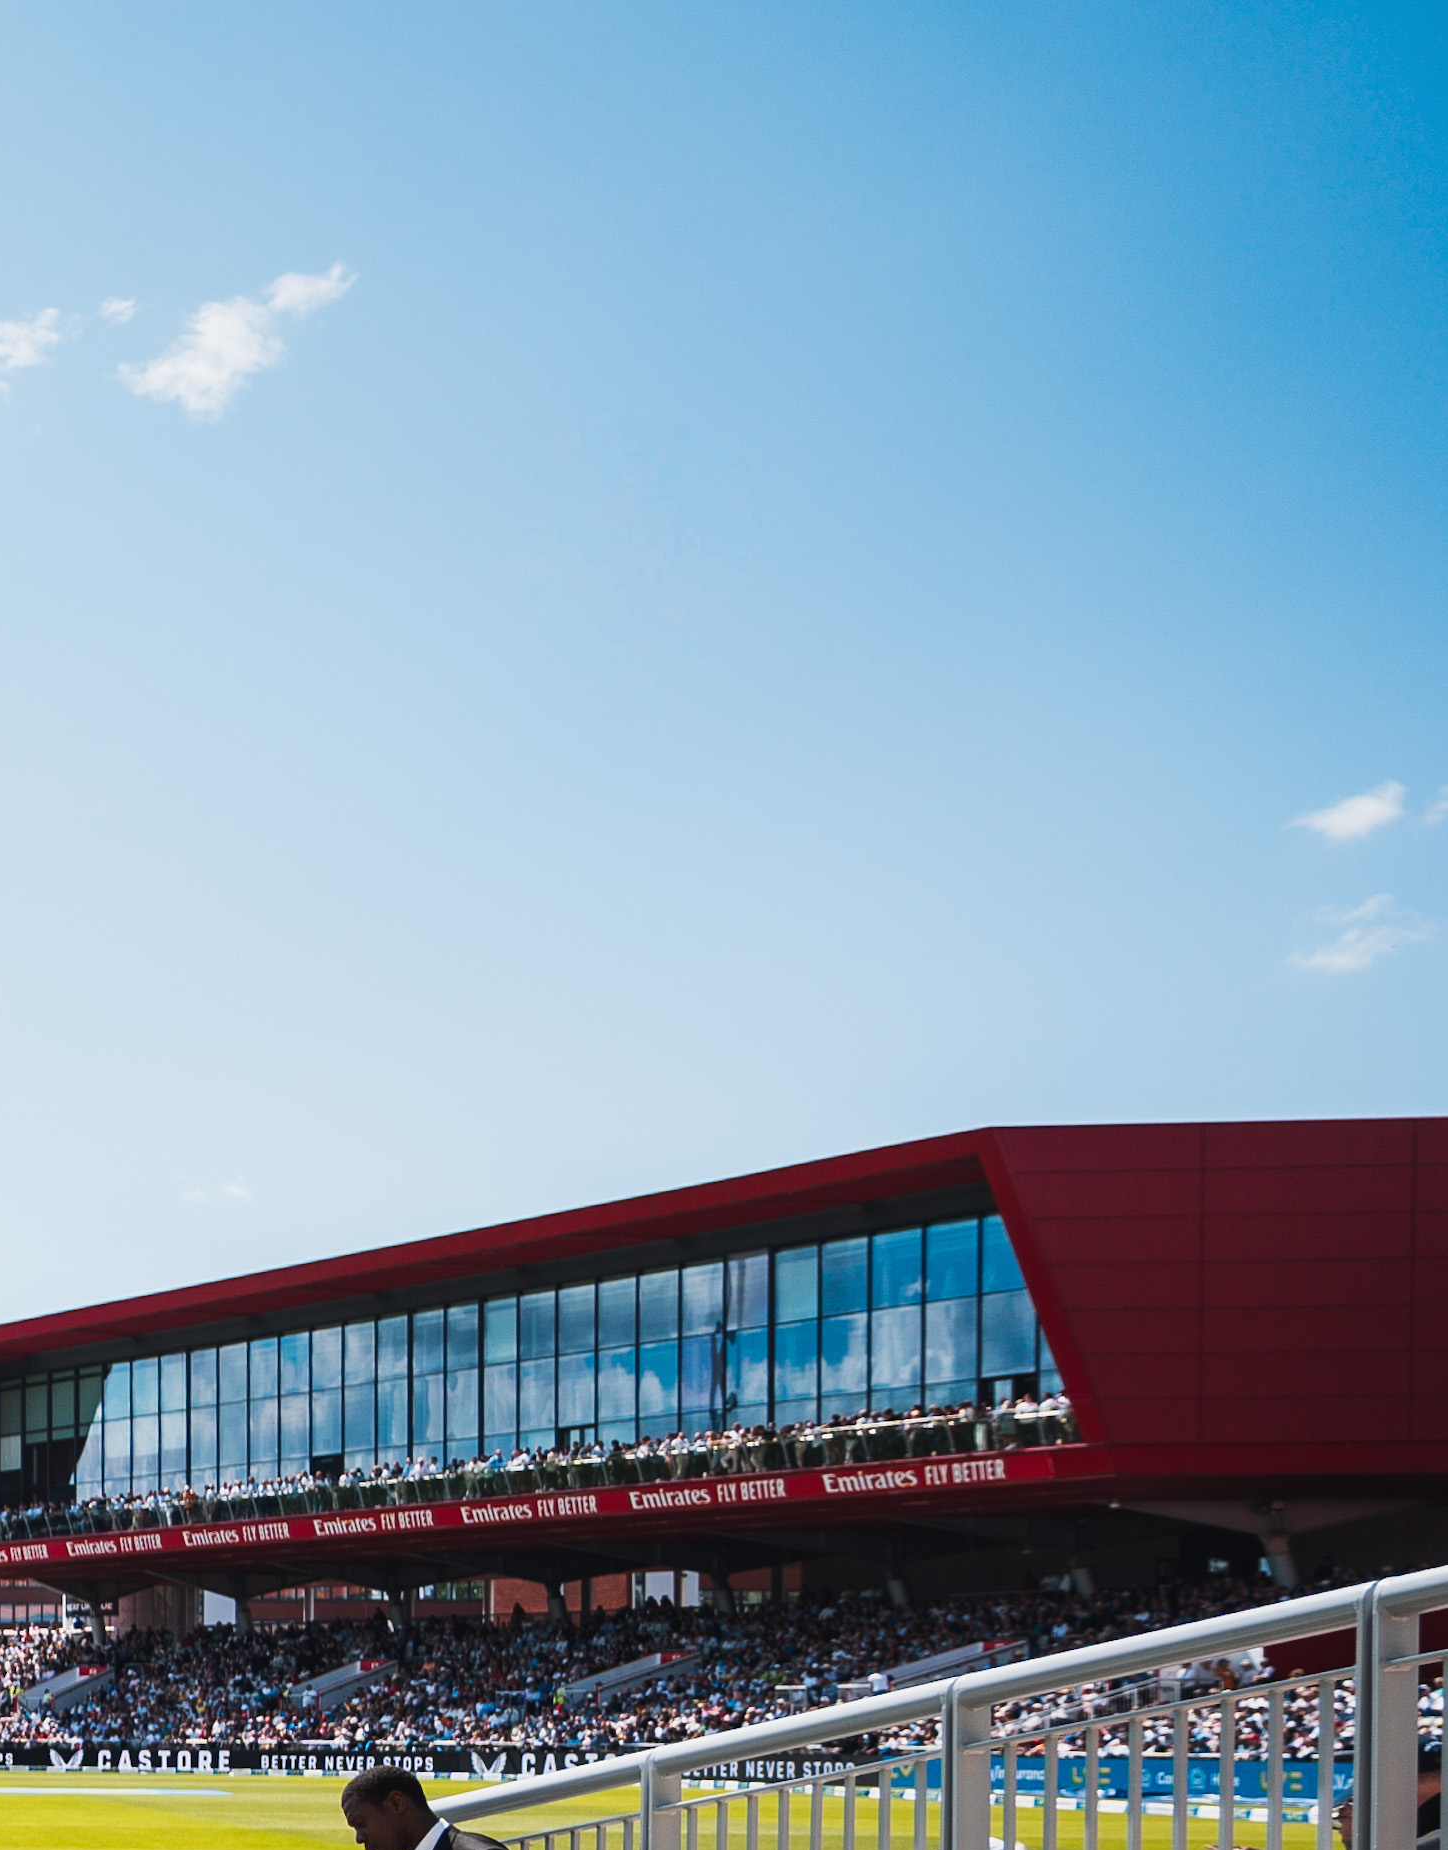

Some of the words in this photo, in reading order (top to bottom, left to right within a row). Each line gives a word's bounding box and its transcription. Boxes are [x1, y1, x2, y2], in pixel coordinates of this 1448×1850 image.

[821, 1468, 918, 1494] Emirates
[924, 1463, 948, 1486] FLY
[952, 1458, 1007, 1483] BETTER
[628, 1486, 711, 1511] Emirates
[717, 1482, 737, 1504] FLY
[740, 1478, 787, 1500] BETTER
[312, 1514, 377, 1537] Emirates
[379, 1512, 396, 1532] FLY
[398, 1509, 435, 1529] BETTER
[460, 1502, 532, 1525] Emirates
[536, 1500, 555, 1518] FLY
[557, 1495, 598, 1515] BETTER
[65, 1537, 118, 1558] Emirates
[119, 1535, 133, 1553] FLY
[134, 1533, 163, 1551] BETTER
[182, 1526, 240, 1548] Emirates
[242, 1524, 258, 1543] FLY
[259, 1521, 290, 1541] BETTER
[9, 1546, 22, 1562] FLY
[22, 1543, 49, 1560] BETTER
[96, 1749, 232, 1772] CASTORE
[259, 1754, 318, 1770] BETTER
[324, 1755, 376, 1771] NEVER
[382, 1756, 434, 1772] STOPS
[745, 1761, 796, 1779] NEVER
